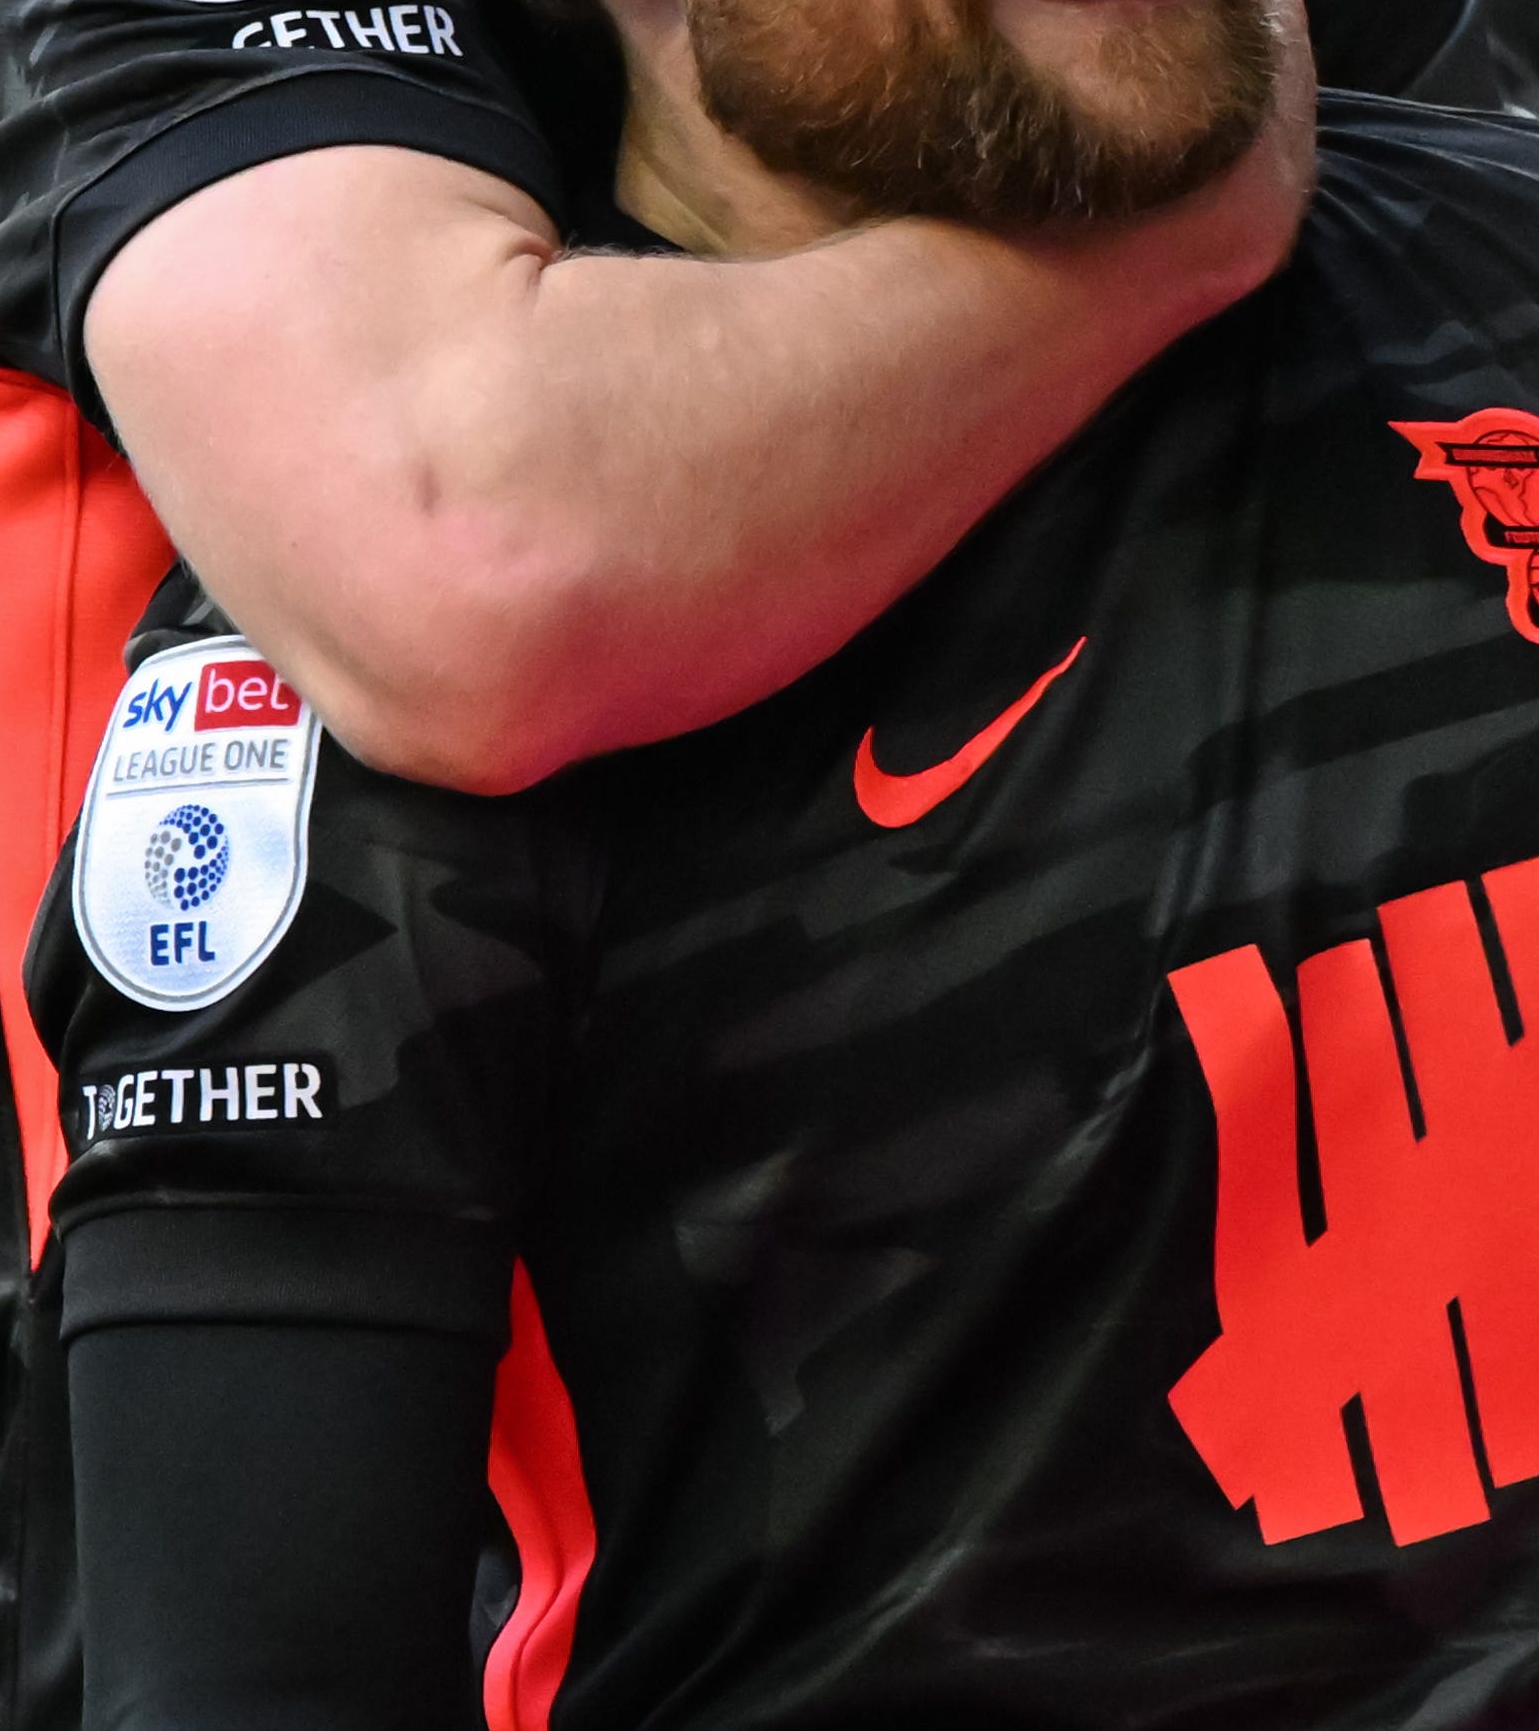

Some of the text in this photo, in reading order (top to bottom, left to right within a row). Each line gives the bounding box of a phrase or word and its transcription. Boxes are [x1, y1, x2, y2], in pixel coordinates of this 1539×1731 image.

[122, 668, 290, 733] sky bet
[113, 738, 289, 783] LEAGUE ONE
[149, 920, 216, 967] EFL
